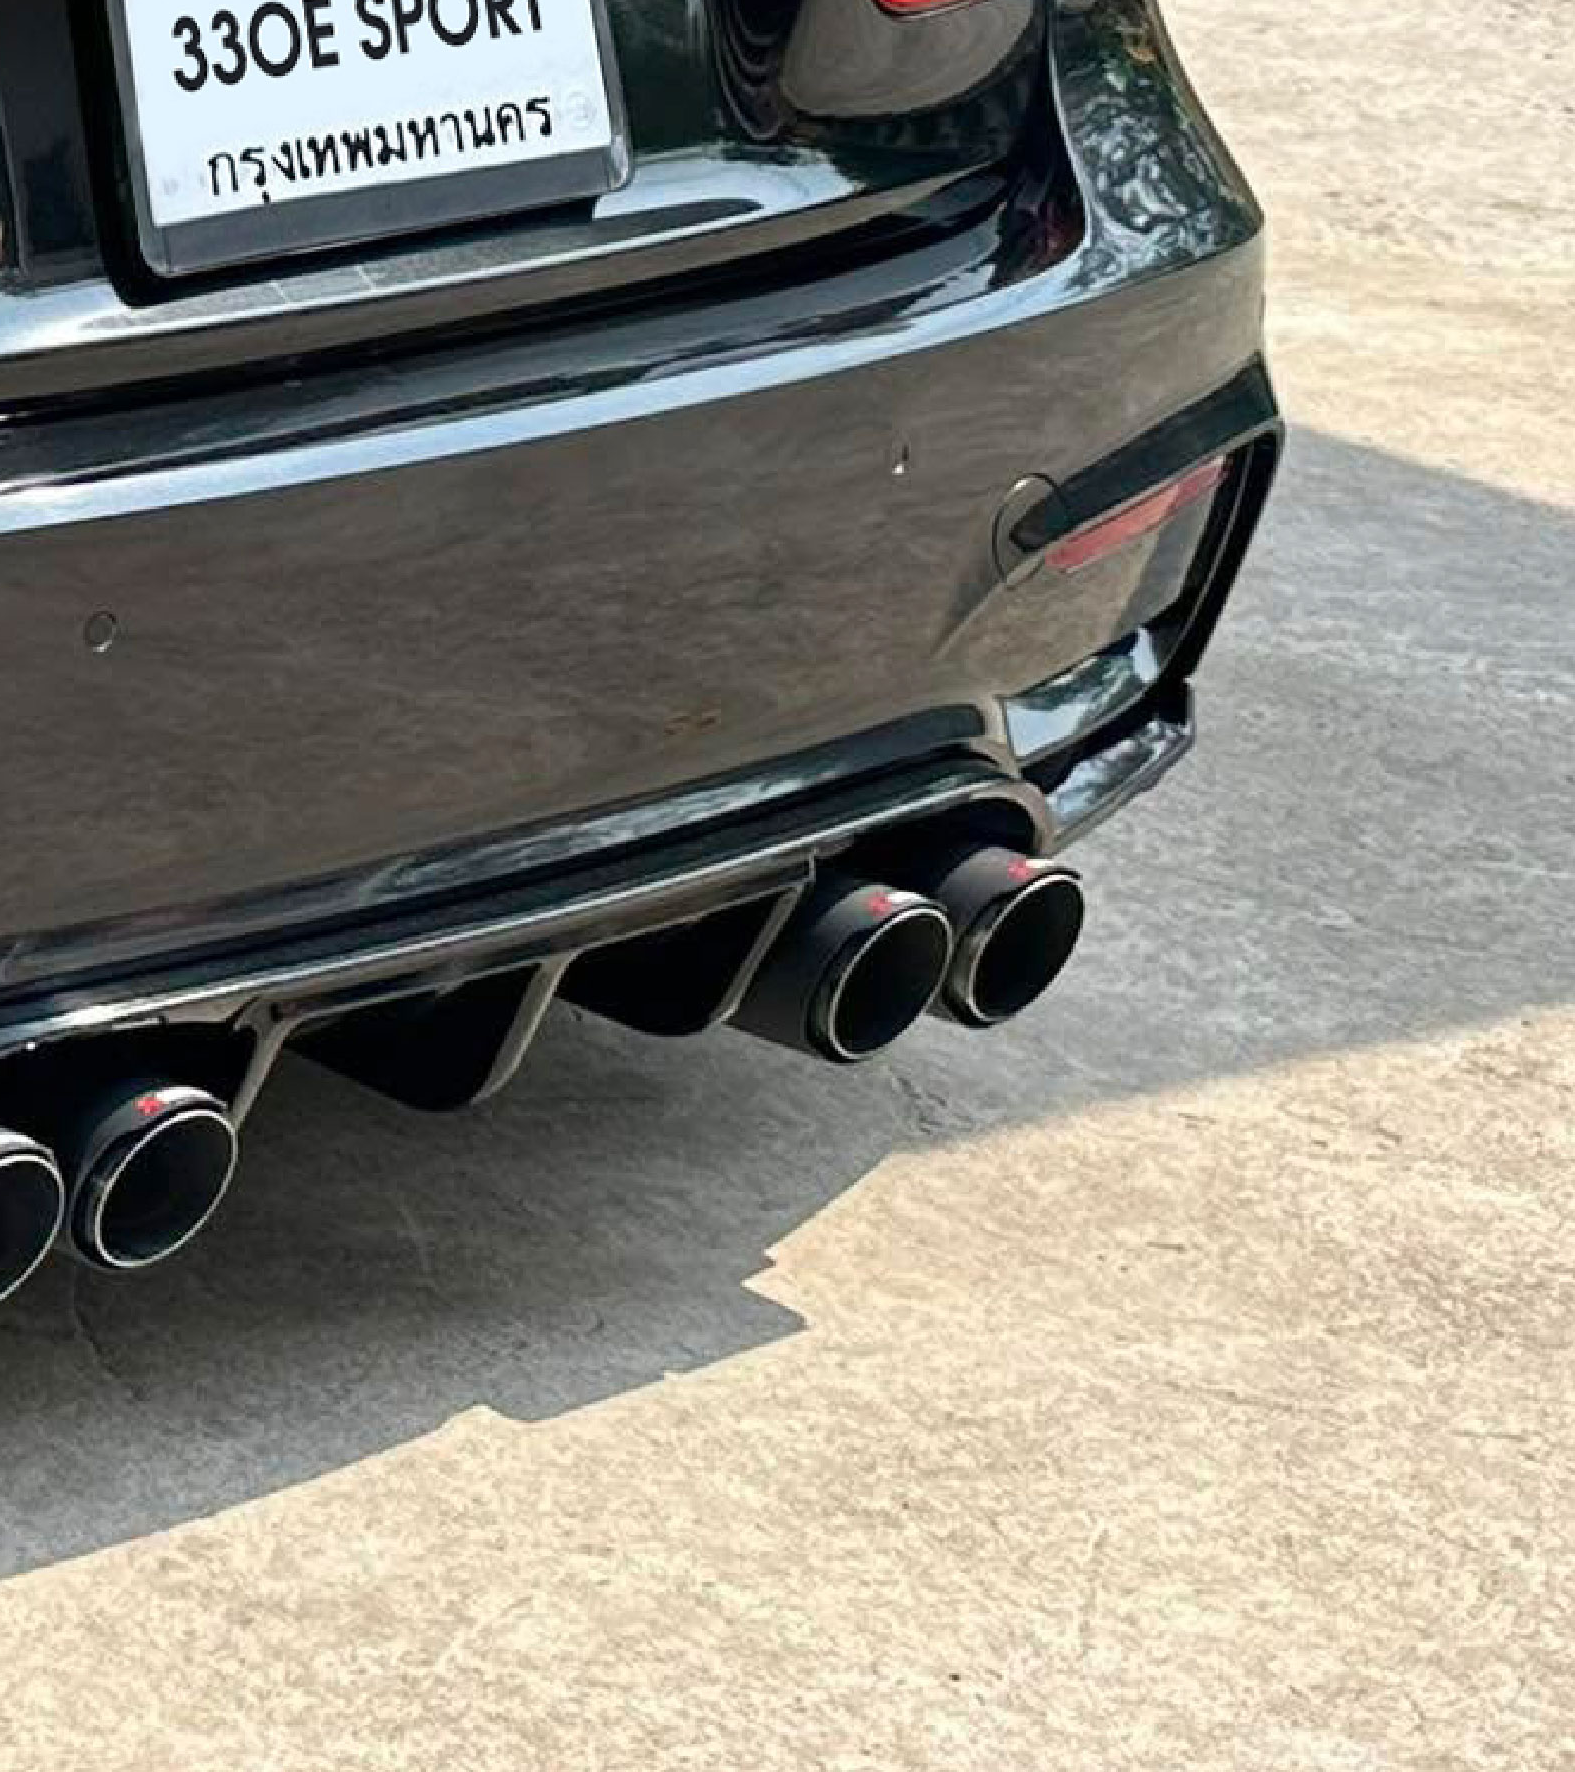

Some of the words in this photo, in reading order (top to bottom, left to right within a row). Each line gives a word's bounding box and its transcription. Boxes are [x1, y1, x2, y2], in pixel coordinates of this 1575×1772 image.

[208, 95, 552, 203] กรุงเทพมหานคร
